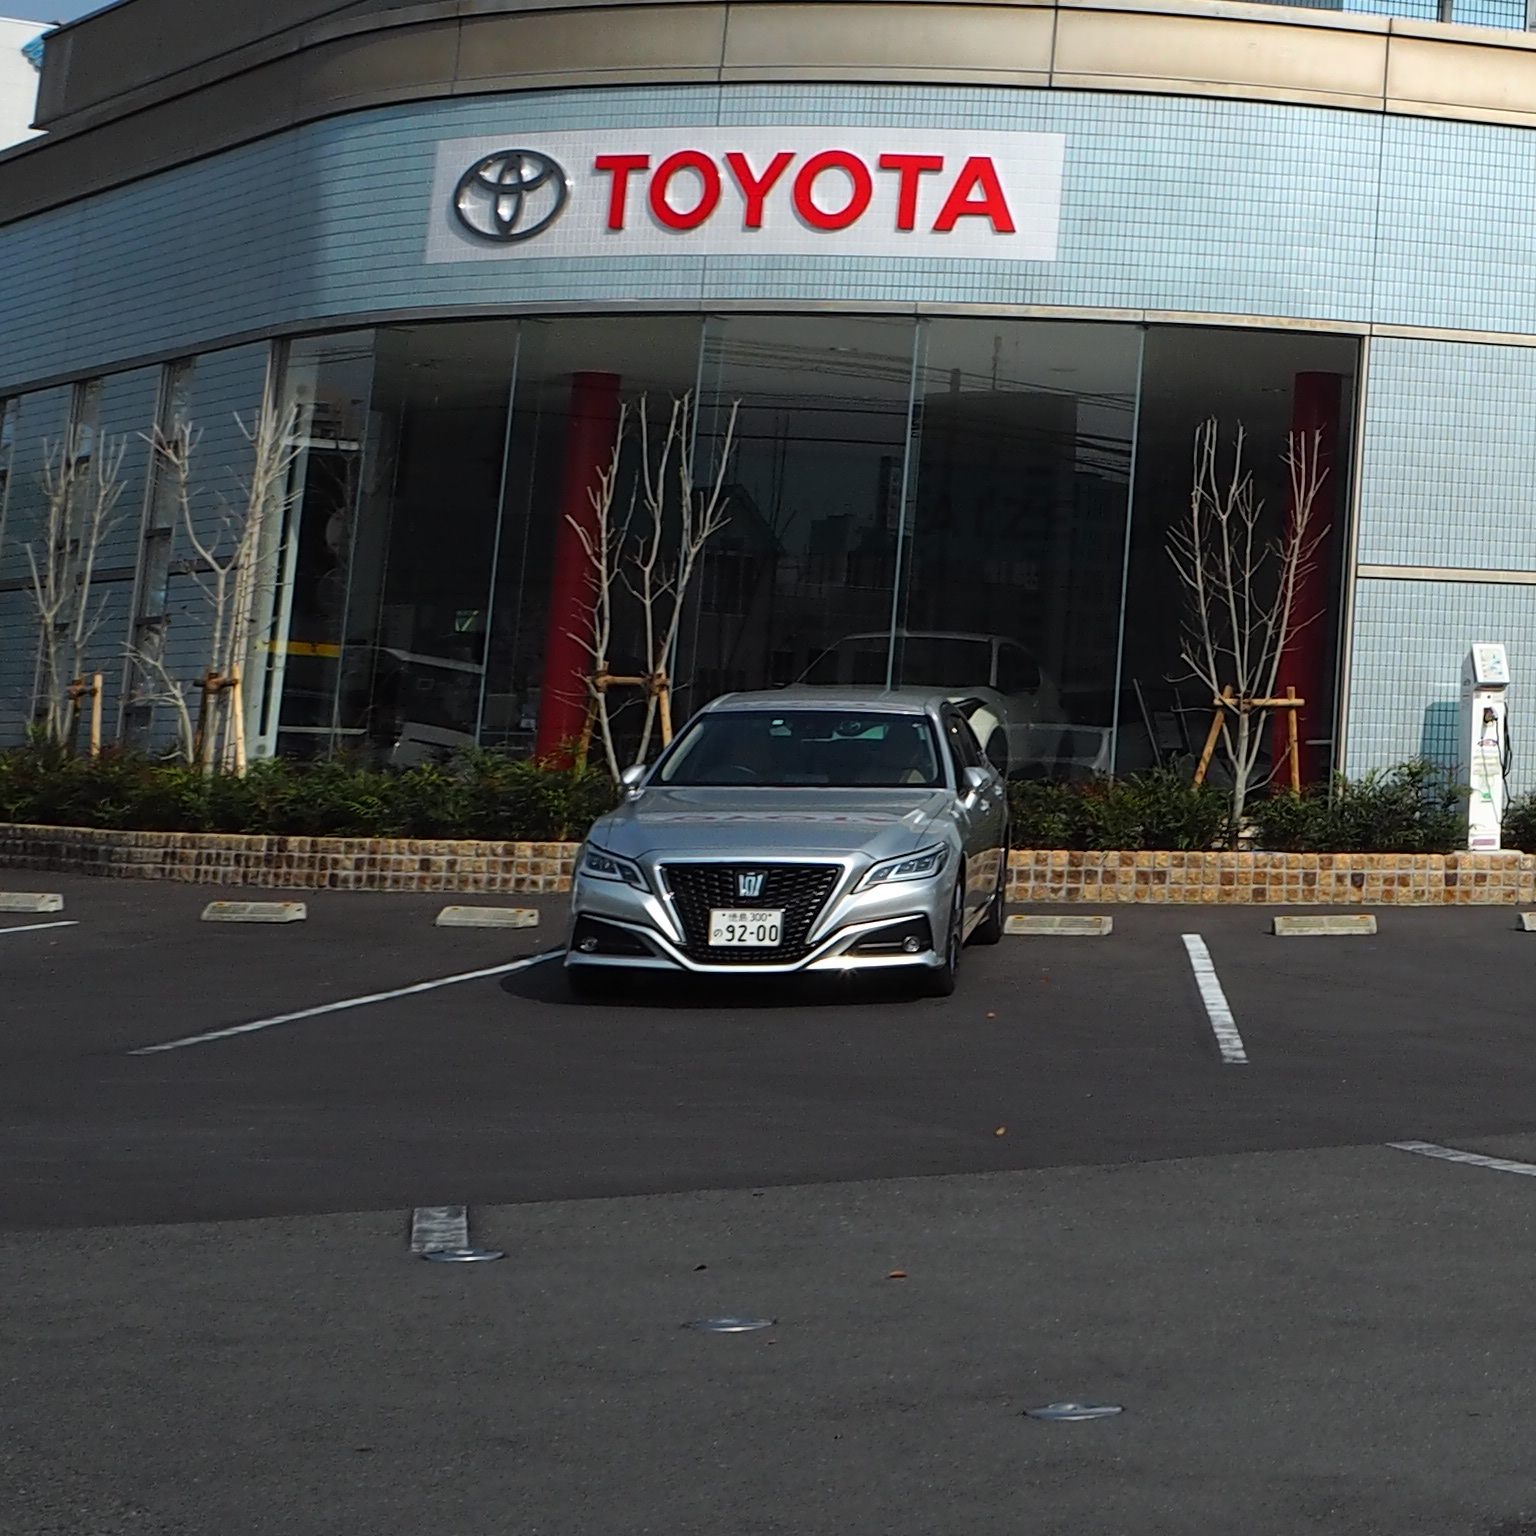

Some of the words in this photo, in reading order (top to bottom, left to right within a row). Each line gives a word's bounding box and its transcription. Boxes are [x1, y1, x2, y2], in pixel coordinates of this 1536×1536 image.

[595, 149, 1017, 234] TOYOTA
[749, 912, 768, 922] 300
[713, 929, 723, 938] の
[725, 925, 778, 942] 92-00
